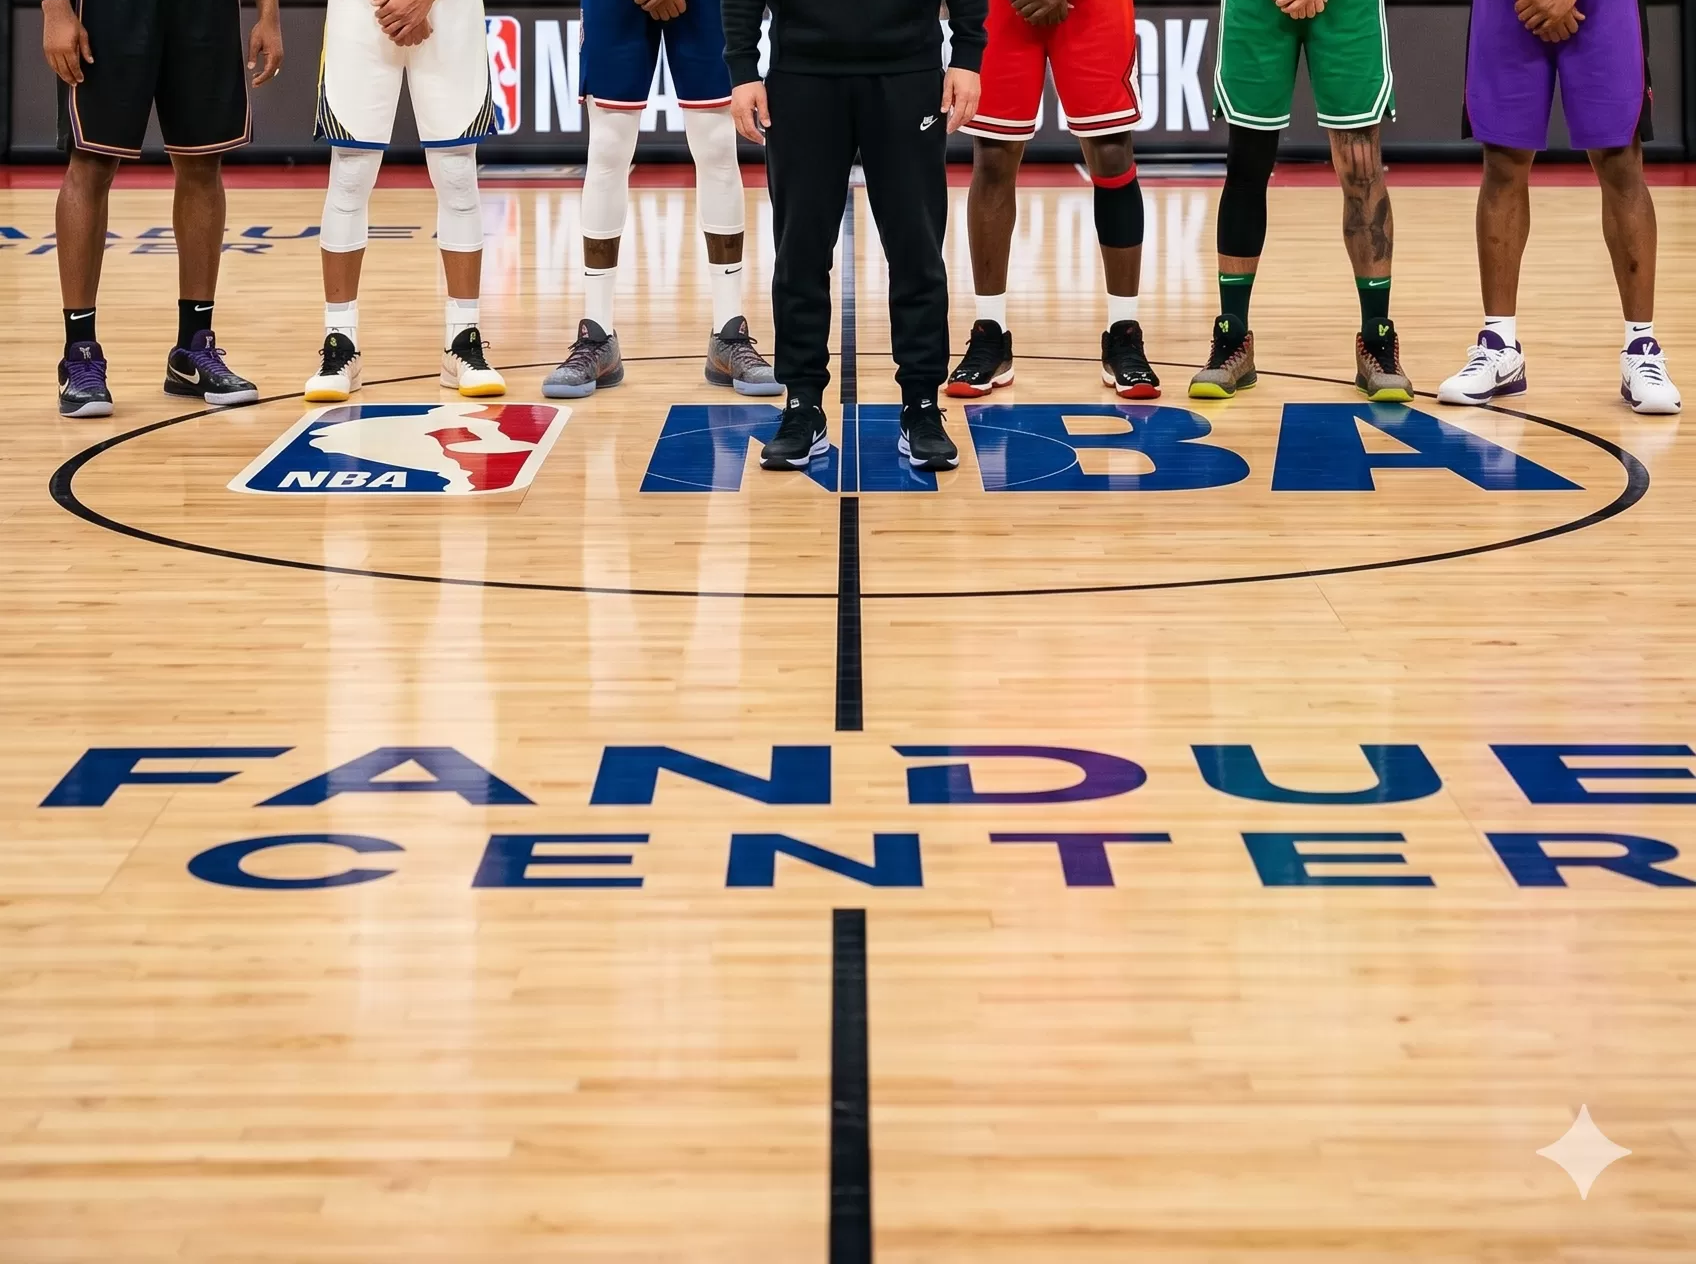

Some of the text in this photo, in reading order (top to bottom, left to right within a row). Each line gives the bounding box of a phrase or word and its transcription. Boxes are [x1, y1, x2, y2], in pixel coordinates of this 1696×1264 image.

[535, 19, 693, 132] NA
[276, 471, 407, 488] NBA
[639, 403, 1584, 493] NBA
[37, 744, 1696, 808] FANDUE
[187, 832, 1696, 888] CENTER
